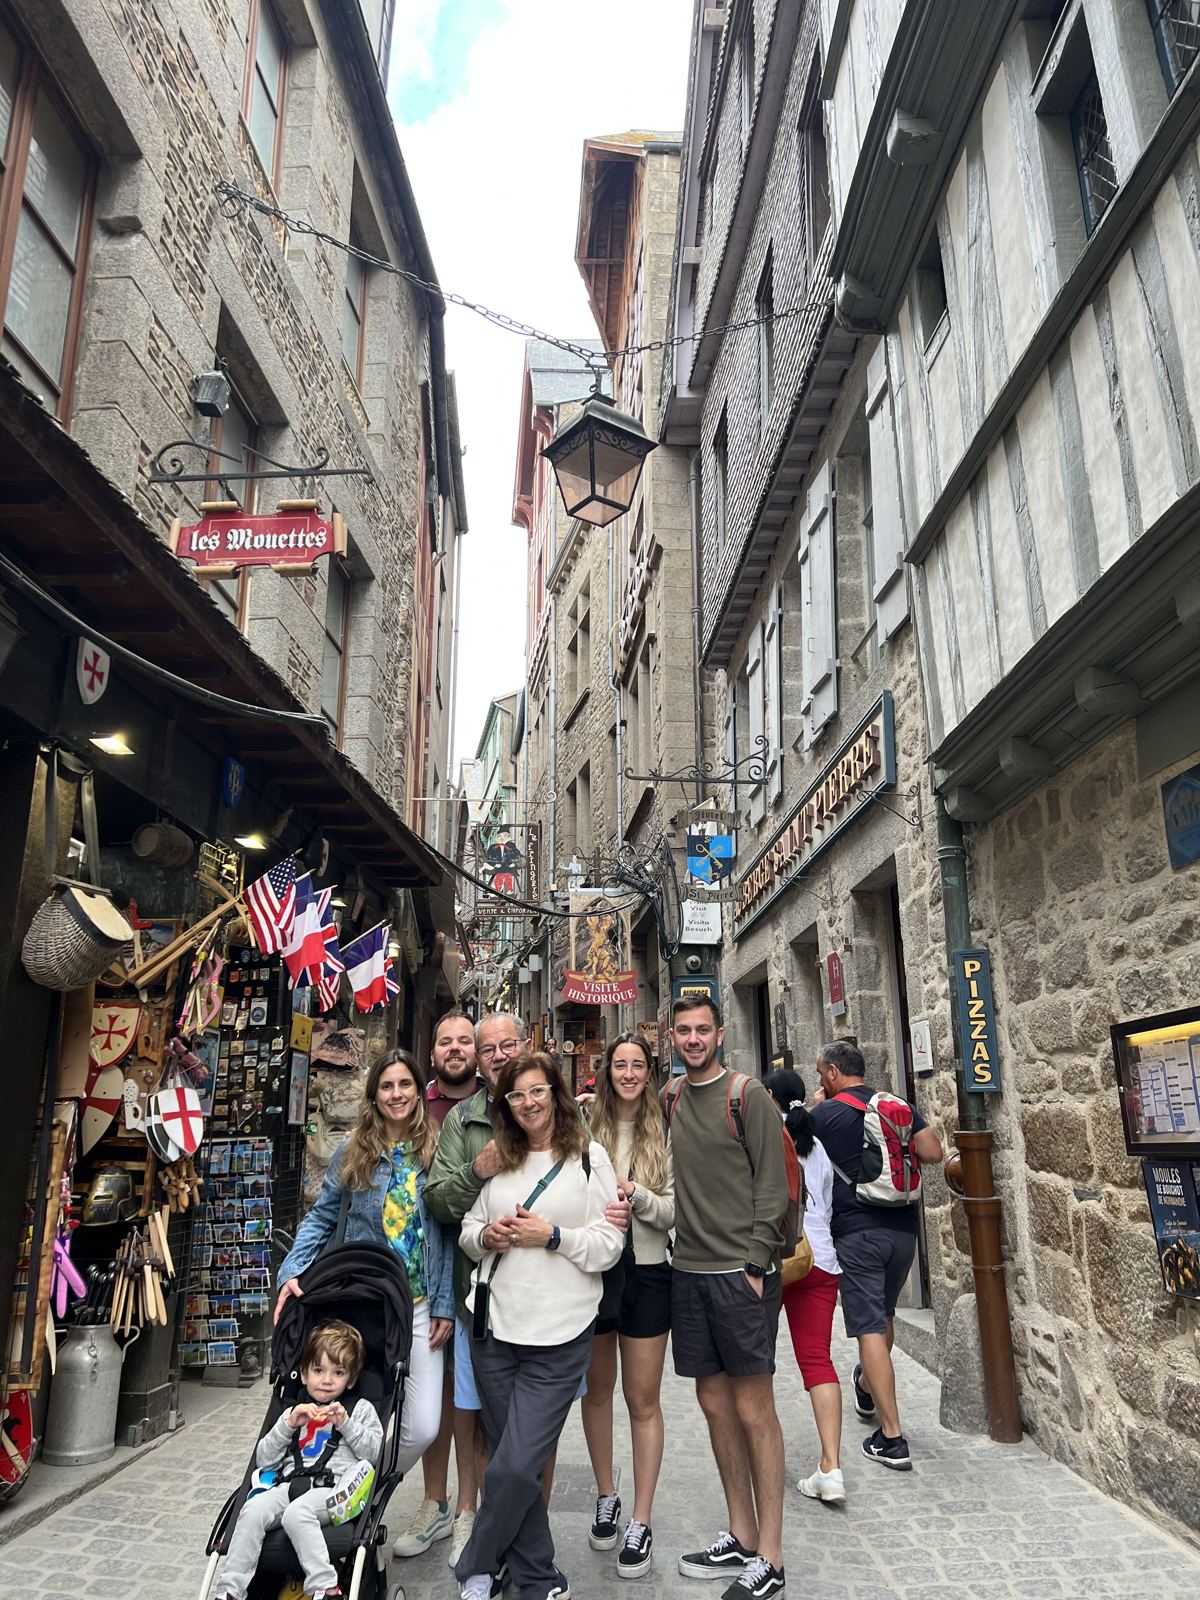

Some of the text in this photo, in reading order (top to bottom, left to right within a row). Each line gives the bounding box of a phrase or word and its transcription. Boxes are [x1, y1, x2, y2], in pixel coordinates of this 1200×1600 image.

[190, 526, 328, 552] les Mouettes
[734, 723, 881, 922] UBERGE SAINT PIERRE
[706, 891, 734, 901] Pierre
[583, 982, 620, 993] VISITE
[567, 988, 636, 1004] HISTORIQUE
[963, 960, 993, 1084] PIZZAS
[1152, 1167, 1181, 1183] MOULES
[1156, 1184, 1184, 1196] DE BOUCHOT
